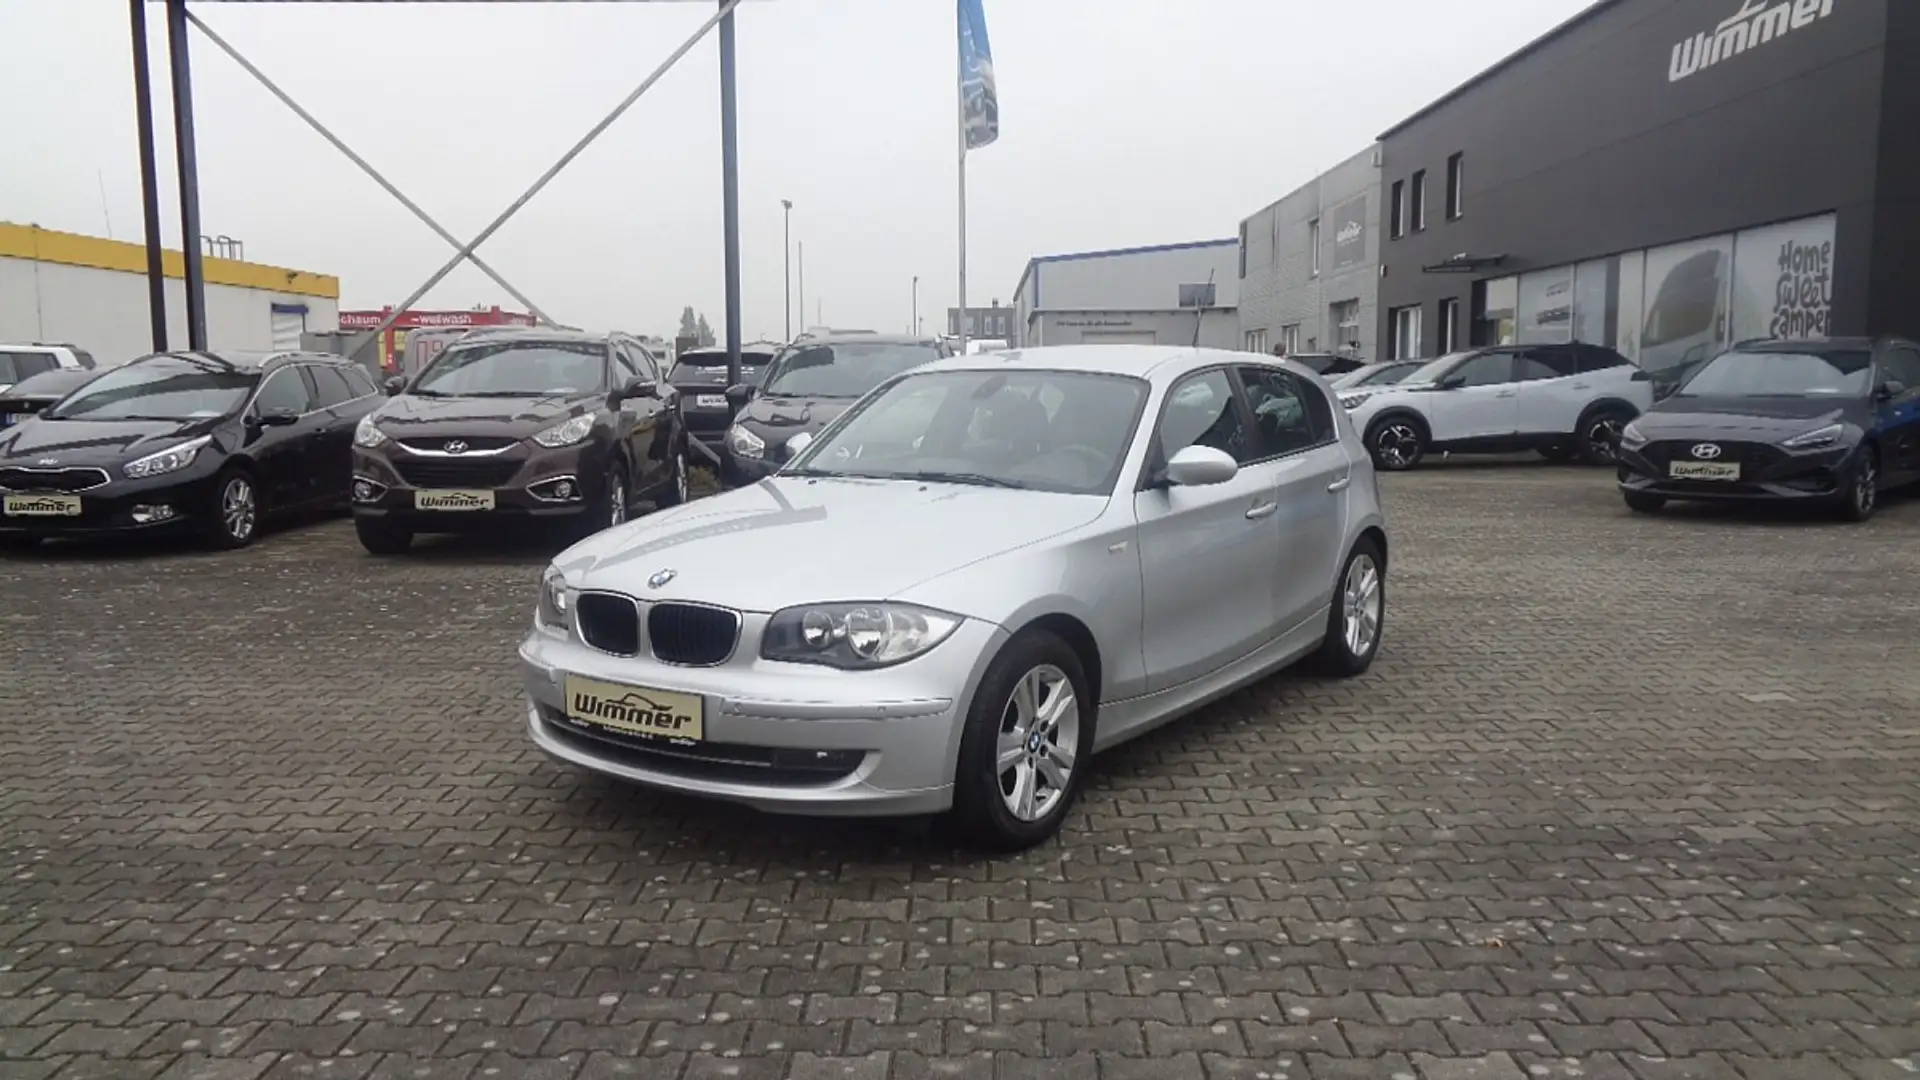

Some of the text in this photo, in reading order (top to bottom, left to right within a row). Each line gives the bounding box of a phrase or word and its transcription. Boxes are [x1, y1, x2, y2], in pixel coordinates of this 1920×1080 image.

[1778, 240, 1831, 274] Home
[340, 314, 380, 325] chaum
[574, 692, 692, 729] Wimmer
